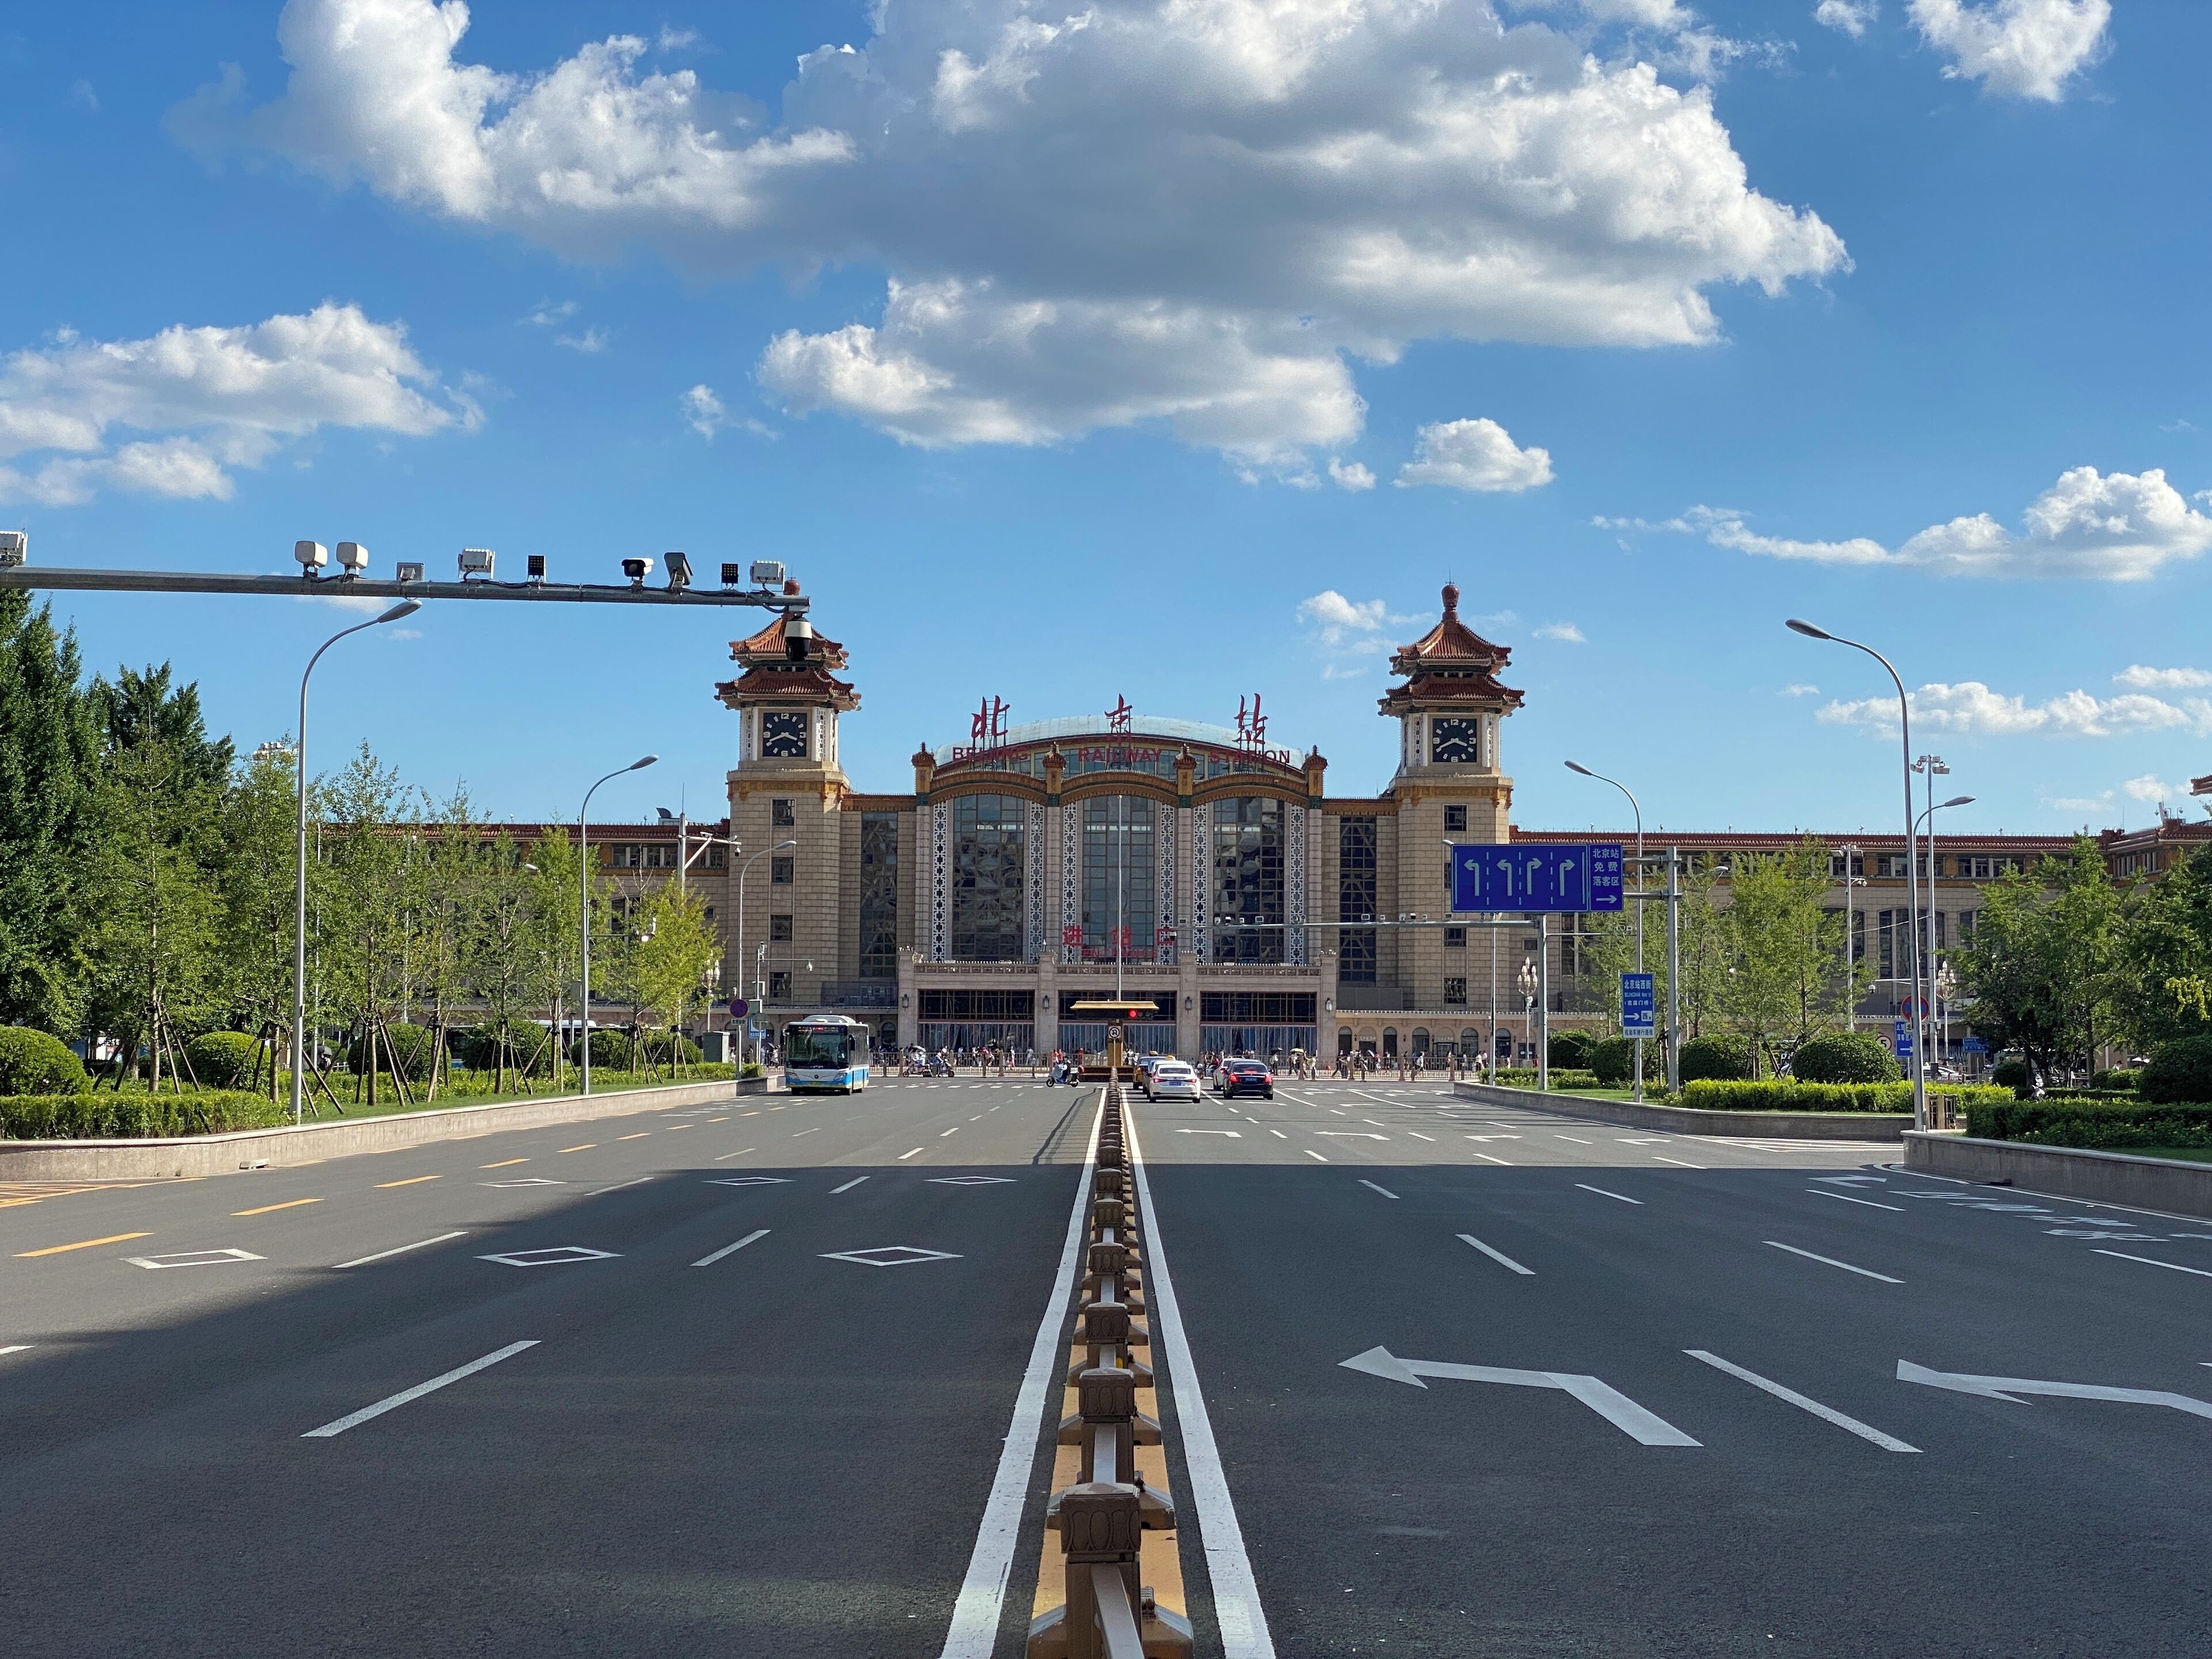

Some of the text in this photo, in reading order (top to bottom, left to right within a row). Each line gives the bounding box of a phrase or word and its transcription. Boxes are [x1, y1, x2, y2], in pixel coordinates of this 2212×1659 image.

[971, 693, 1268, 745] 北京站
[1078, 748, 1161, 762] RAILWAY
[1209, 750, 1289, 764] STATION
[1593, 849, 1619, 858] 北京站
[1594, 862, 1618, 872] 免费
[1593, 876, 1619, 886] 落客区
[1624, 979, 1651, 989] 北京站西街
[1880, 1039, 1887, 1048] 5
